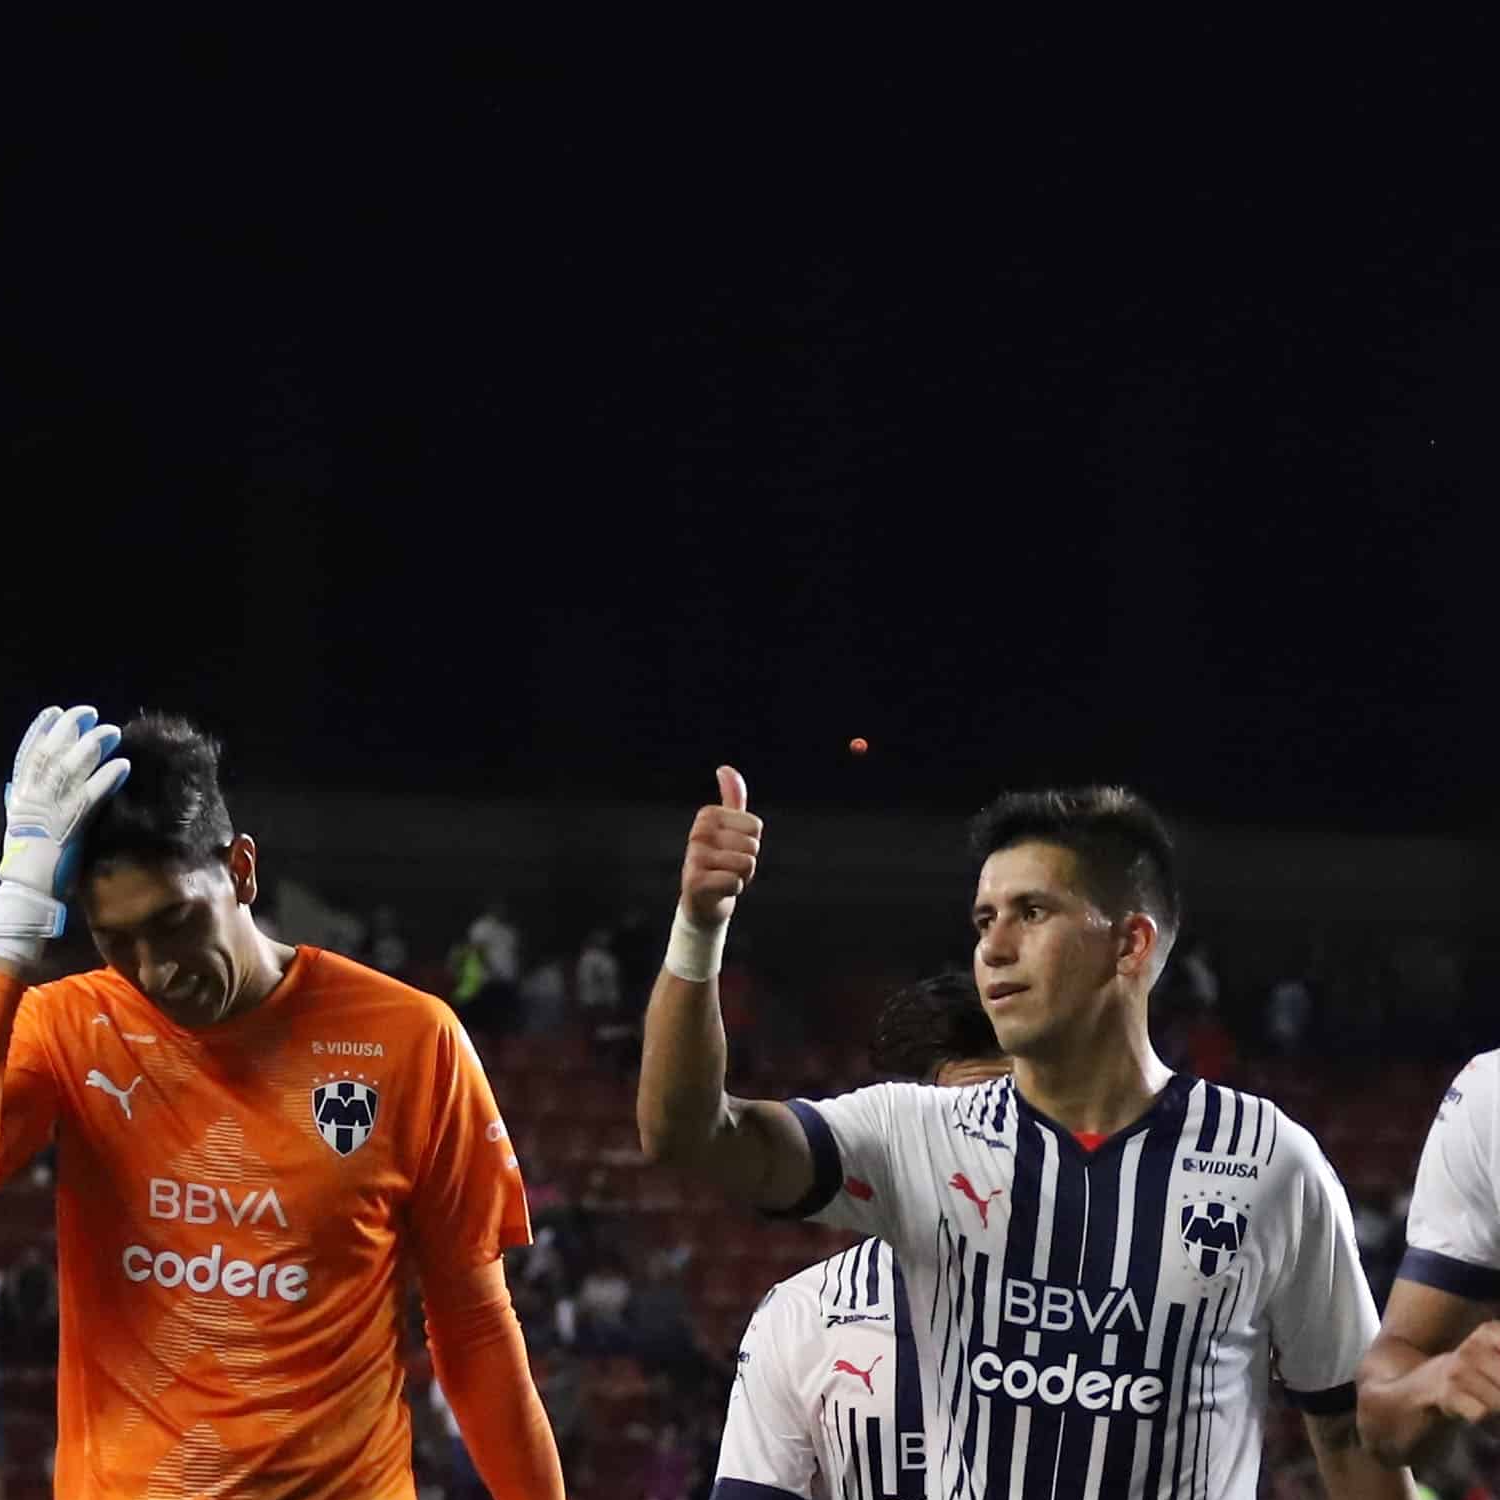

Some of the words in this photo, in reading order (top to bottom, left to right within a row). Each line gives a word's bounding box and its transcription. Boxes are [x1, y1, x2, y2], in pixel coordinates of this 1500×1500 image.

[327, 1042, 384, 1057] VIDUSA
[1199, 1160, 1258, 1180] VIDUSA
[148, 1177, 289, 1229] BBVA
[122, 1243, 310, 1302] codere
[1003, 1278, 1144, 1333] BBVA
[970, 1354, 1166, 1415] codere
